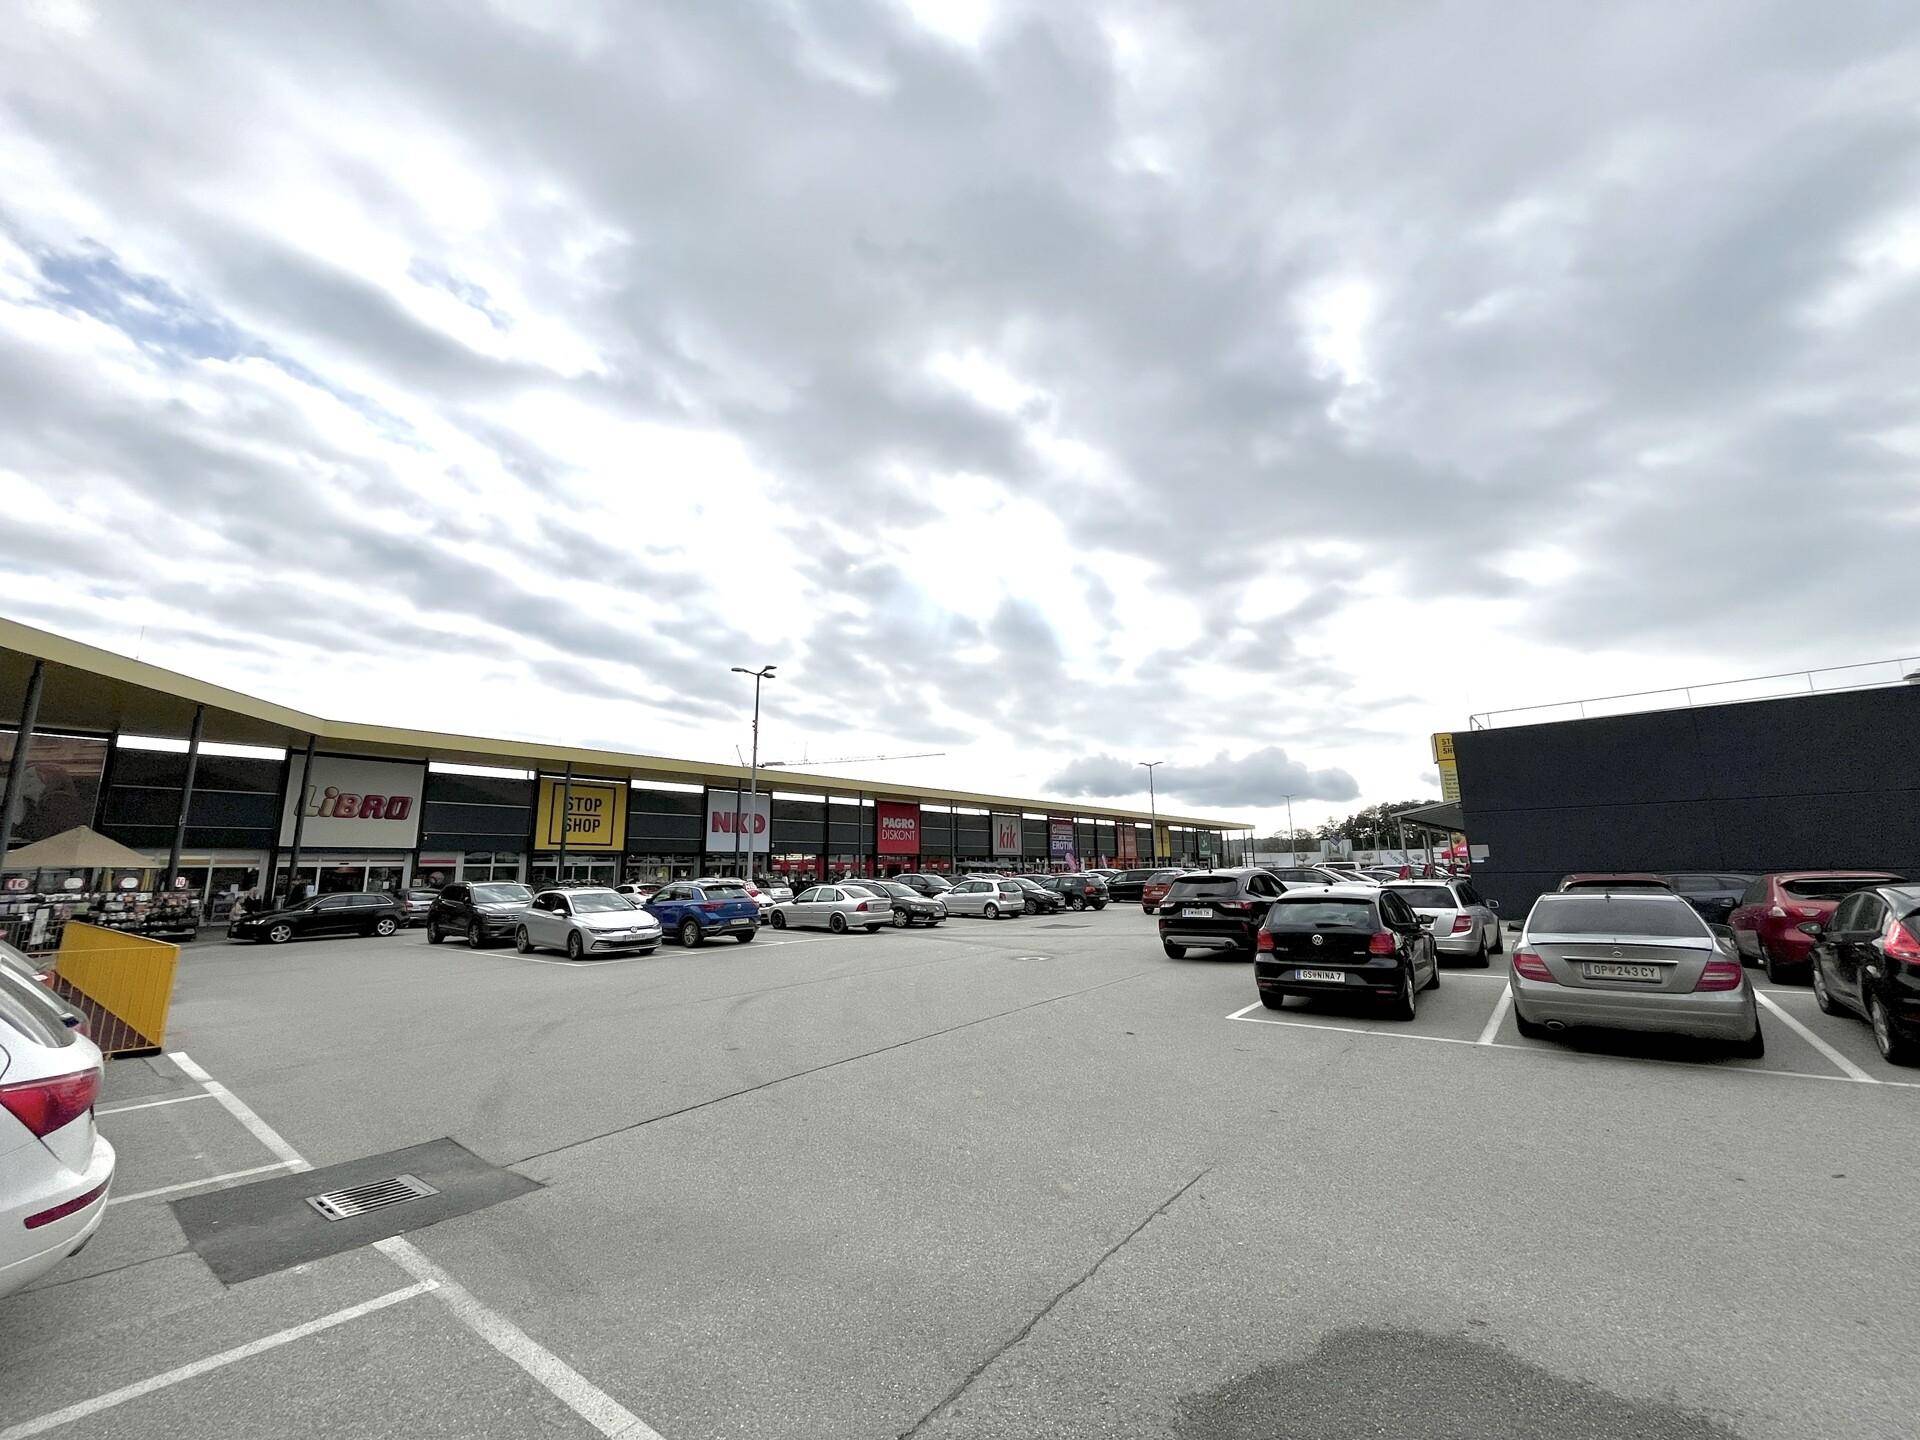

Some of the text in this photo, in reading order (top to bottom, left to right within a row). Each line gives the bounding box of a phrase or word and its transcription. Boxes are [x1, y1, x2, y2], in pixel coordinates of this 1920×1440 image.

[568, 797, 602, 812] STOP
[566, 817, 600, 833] SHOP
[711, 811, 766, 834] NKD
[882, 818, 915, 828] PAGRO
[881, 829, 916, 840] DISKONT
[999, 823, 1016, 849] kik
[1052, 840, 1073, 850] EROTIK
[1303, 970, 1312, 979] GS
[1318, 971, 1335, 980] NINA
[1617, 966, 1638, 976] 243
[1641, 967, 1655, 977] CY
